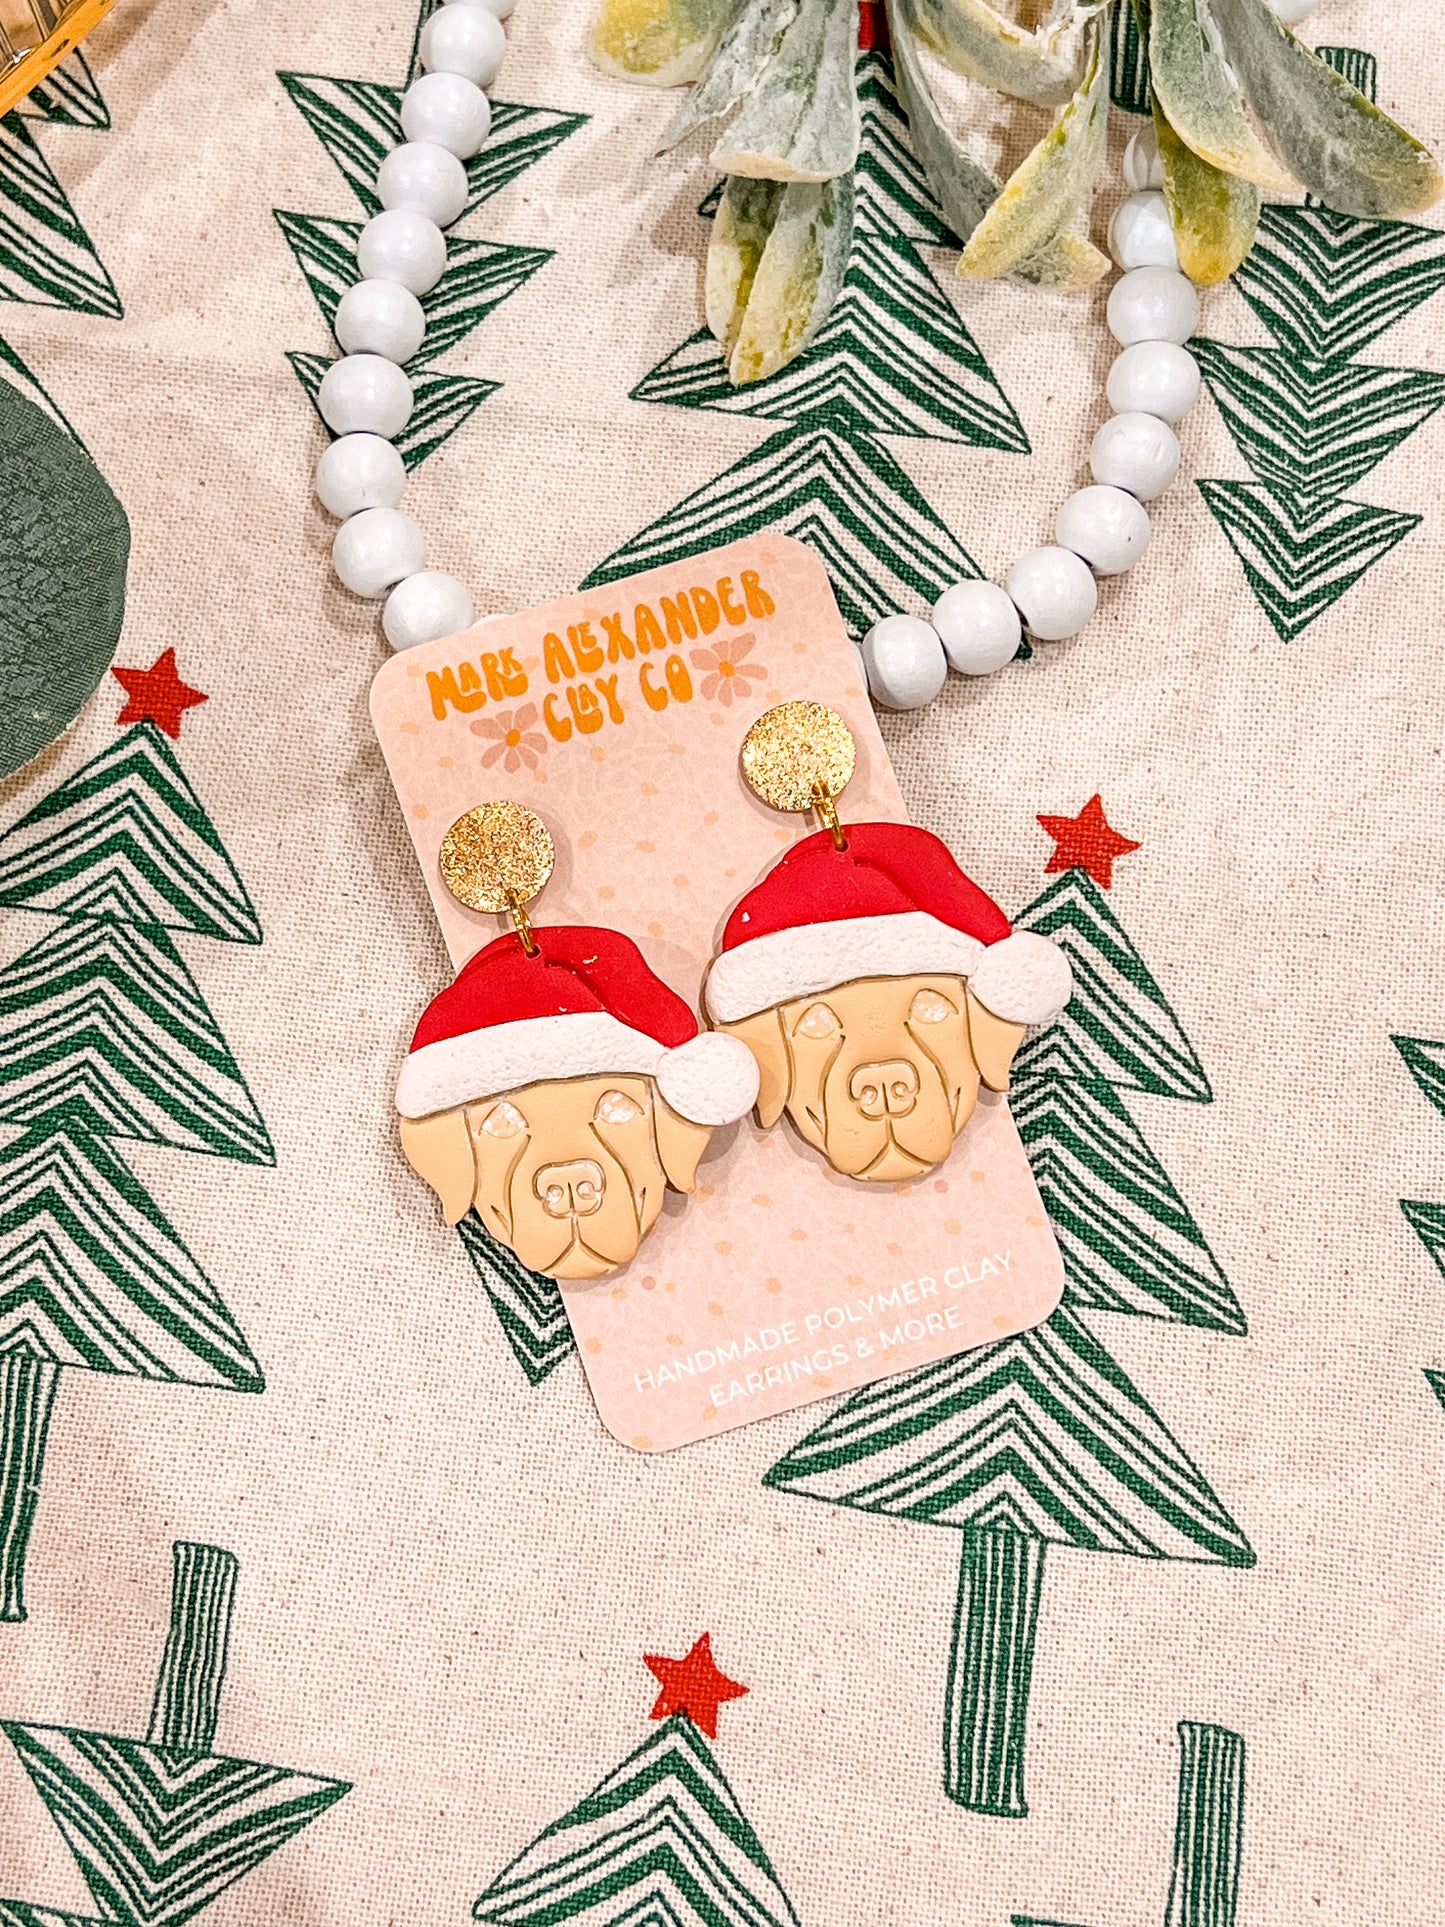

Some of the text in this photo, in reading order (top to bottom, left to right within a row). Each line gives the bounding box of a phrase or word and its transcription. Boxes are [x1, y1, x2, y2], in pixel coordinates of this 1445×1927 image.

[425, 569, 776, 721] MARK ALEXANDER
[543, 654, 693, 742] CLAY CO
[634, 1249, 1013, 1393] HANDMADE POLYMER CLAY
[709, 1306, 964, 1407] EARRINGS & MORE
